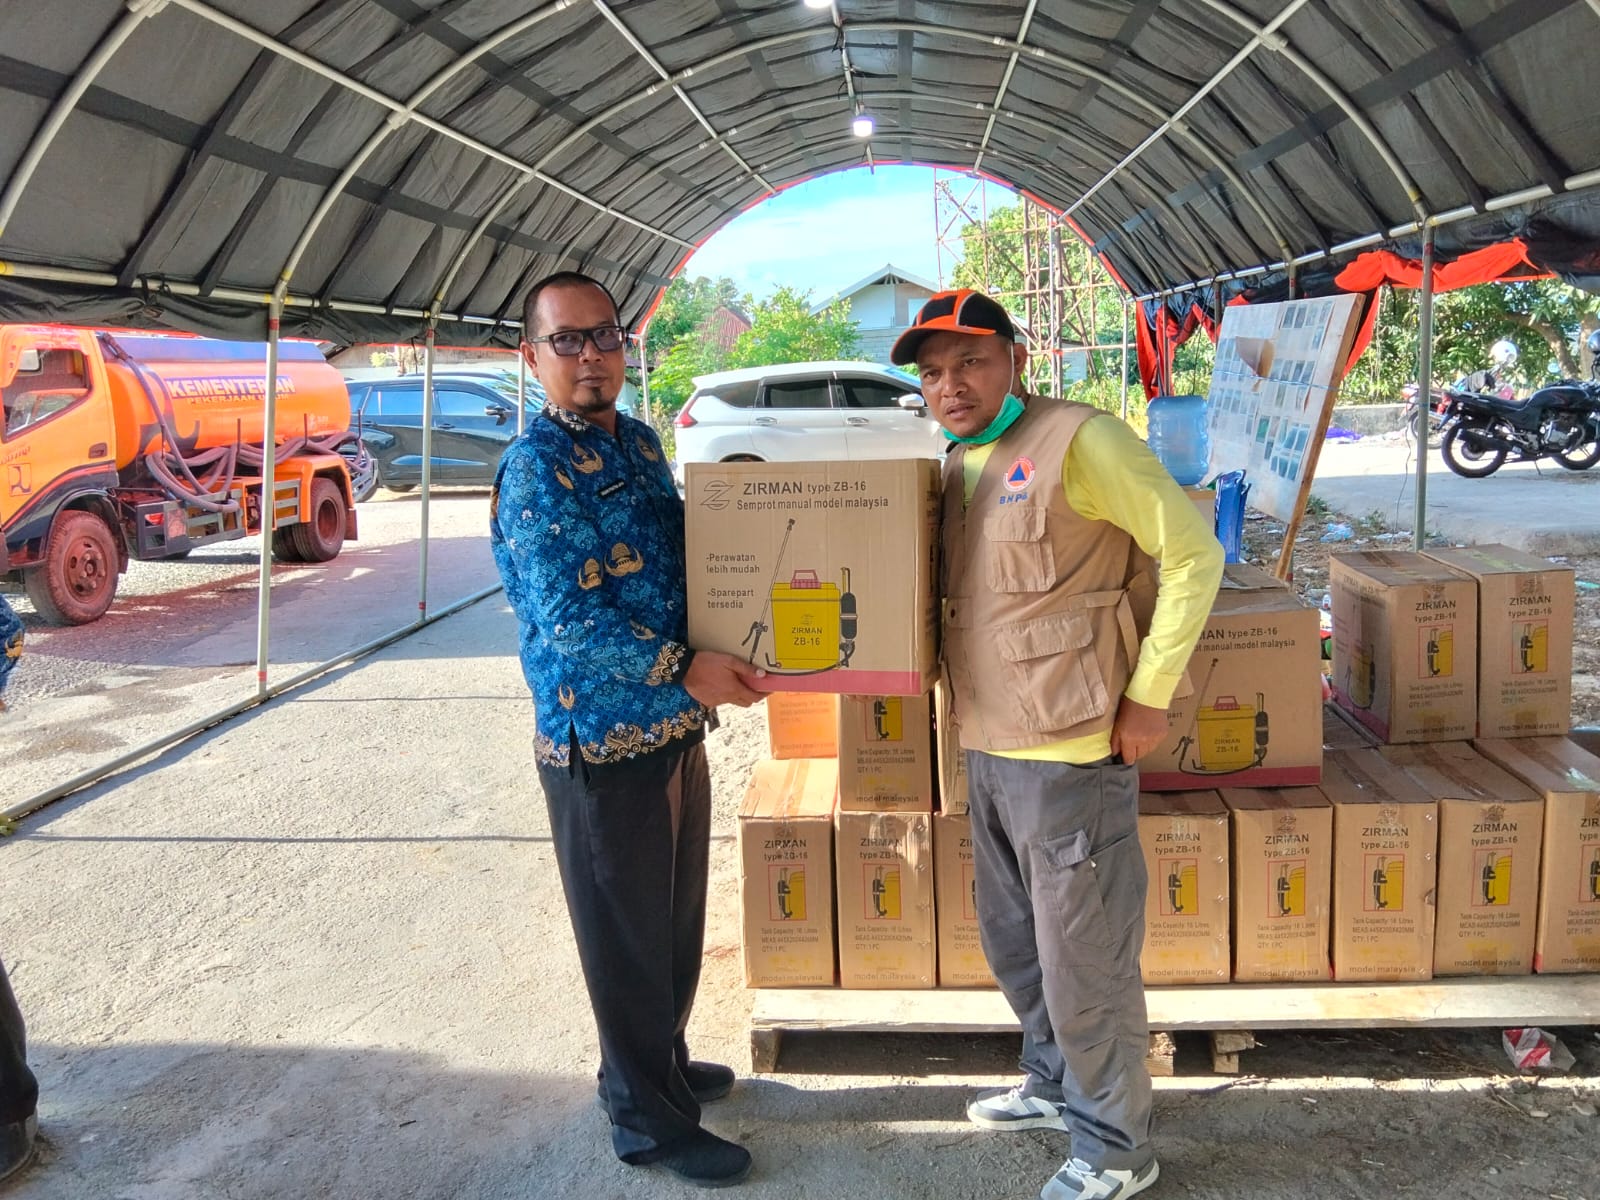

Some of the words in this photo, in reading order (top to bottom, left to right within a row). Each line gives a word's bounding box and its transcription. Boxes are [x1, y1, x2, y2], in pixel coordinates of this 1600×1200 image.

[166, 378, 296, 398] KEMENTERAN
[743, 481, 803, 495] ZIRMAN
[807, 483, 831, 495] type
[834, 481, 867, 492] ZB-16
[737, 499, 776, 512] Semprot
[778, 498, 812, 509] manual
[814, 498, 843, 509] model
[845, 496, 889, 510] malaysia
[706, 553, 756, 562] -Perawatan
[706, 564, 729, 574] lebih
[730, 564, 760, 574] mudah
[707, 588, 754, 599] -Sparepart
[707, 600, 744, 609] tersedia
[1415, 600, 1456, 611] ZIRMAN
[1509, 595, 1552, 606] ZIRMAN
[1415, 614, 1432, 623] type
[1508, 610, 1526, 619] type
[791, 626, 823, 635] ZIRMAN
[1228, 630, 1248, 638] type
[1250, 627, 1278, 637] ZB-16
[793, 637, 821, 646] ZB-16
[1203, 642, 1232, 652] manual
[1234, 640, 1259, 650] model
[1260, 639, 1296, 649] malaysia
[1362, 827, 1409, 837] ZIRMAN
[1472, 823, 1518, 833] ZIRMAN
[1155, 833, 1200, 842] ZIRMAN
[1264, 833, 1309, 845] ZIRMAN
[1471, 837, 1490, 846] type
[1491, 836, 1518, 845] ZB-16
[1579, 832, 1598, 841] type
[764, 840, 807, 849] ZIRMAN
[860, 838, 903, 848] ZIRMAN
[1361, 841, 1381, 850] type
[1382, 840, 1410, 849] ZB-16
[1155, 846, 1174, 855] type
[1176, 845, 1202, 853] ZB-16
[1264, 849, 1283, 857] type
[1284, 847, 1310, 856] ZB-16
